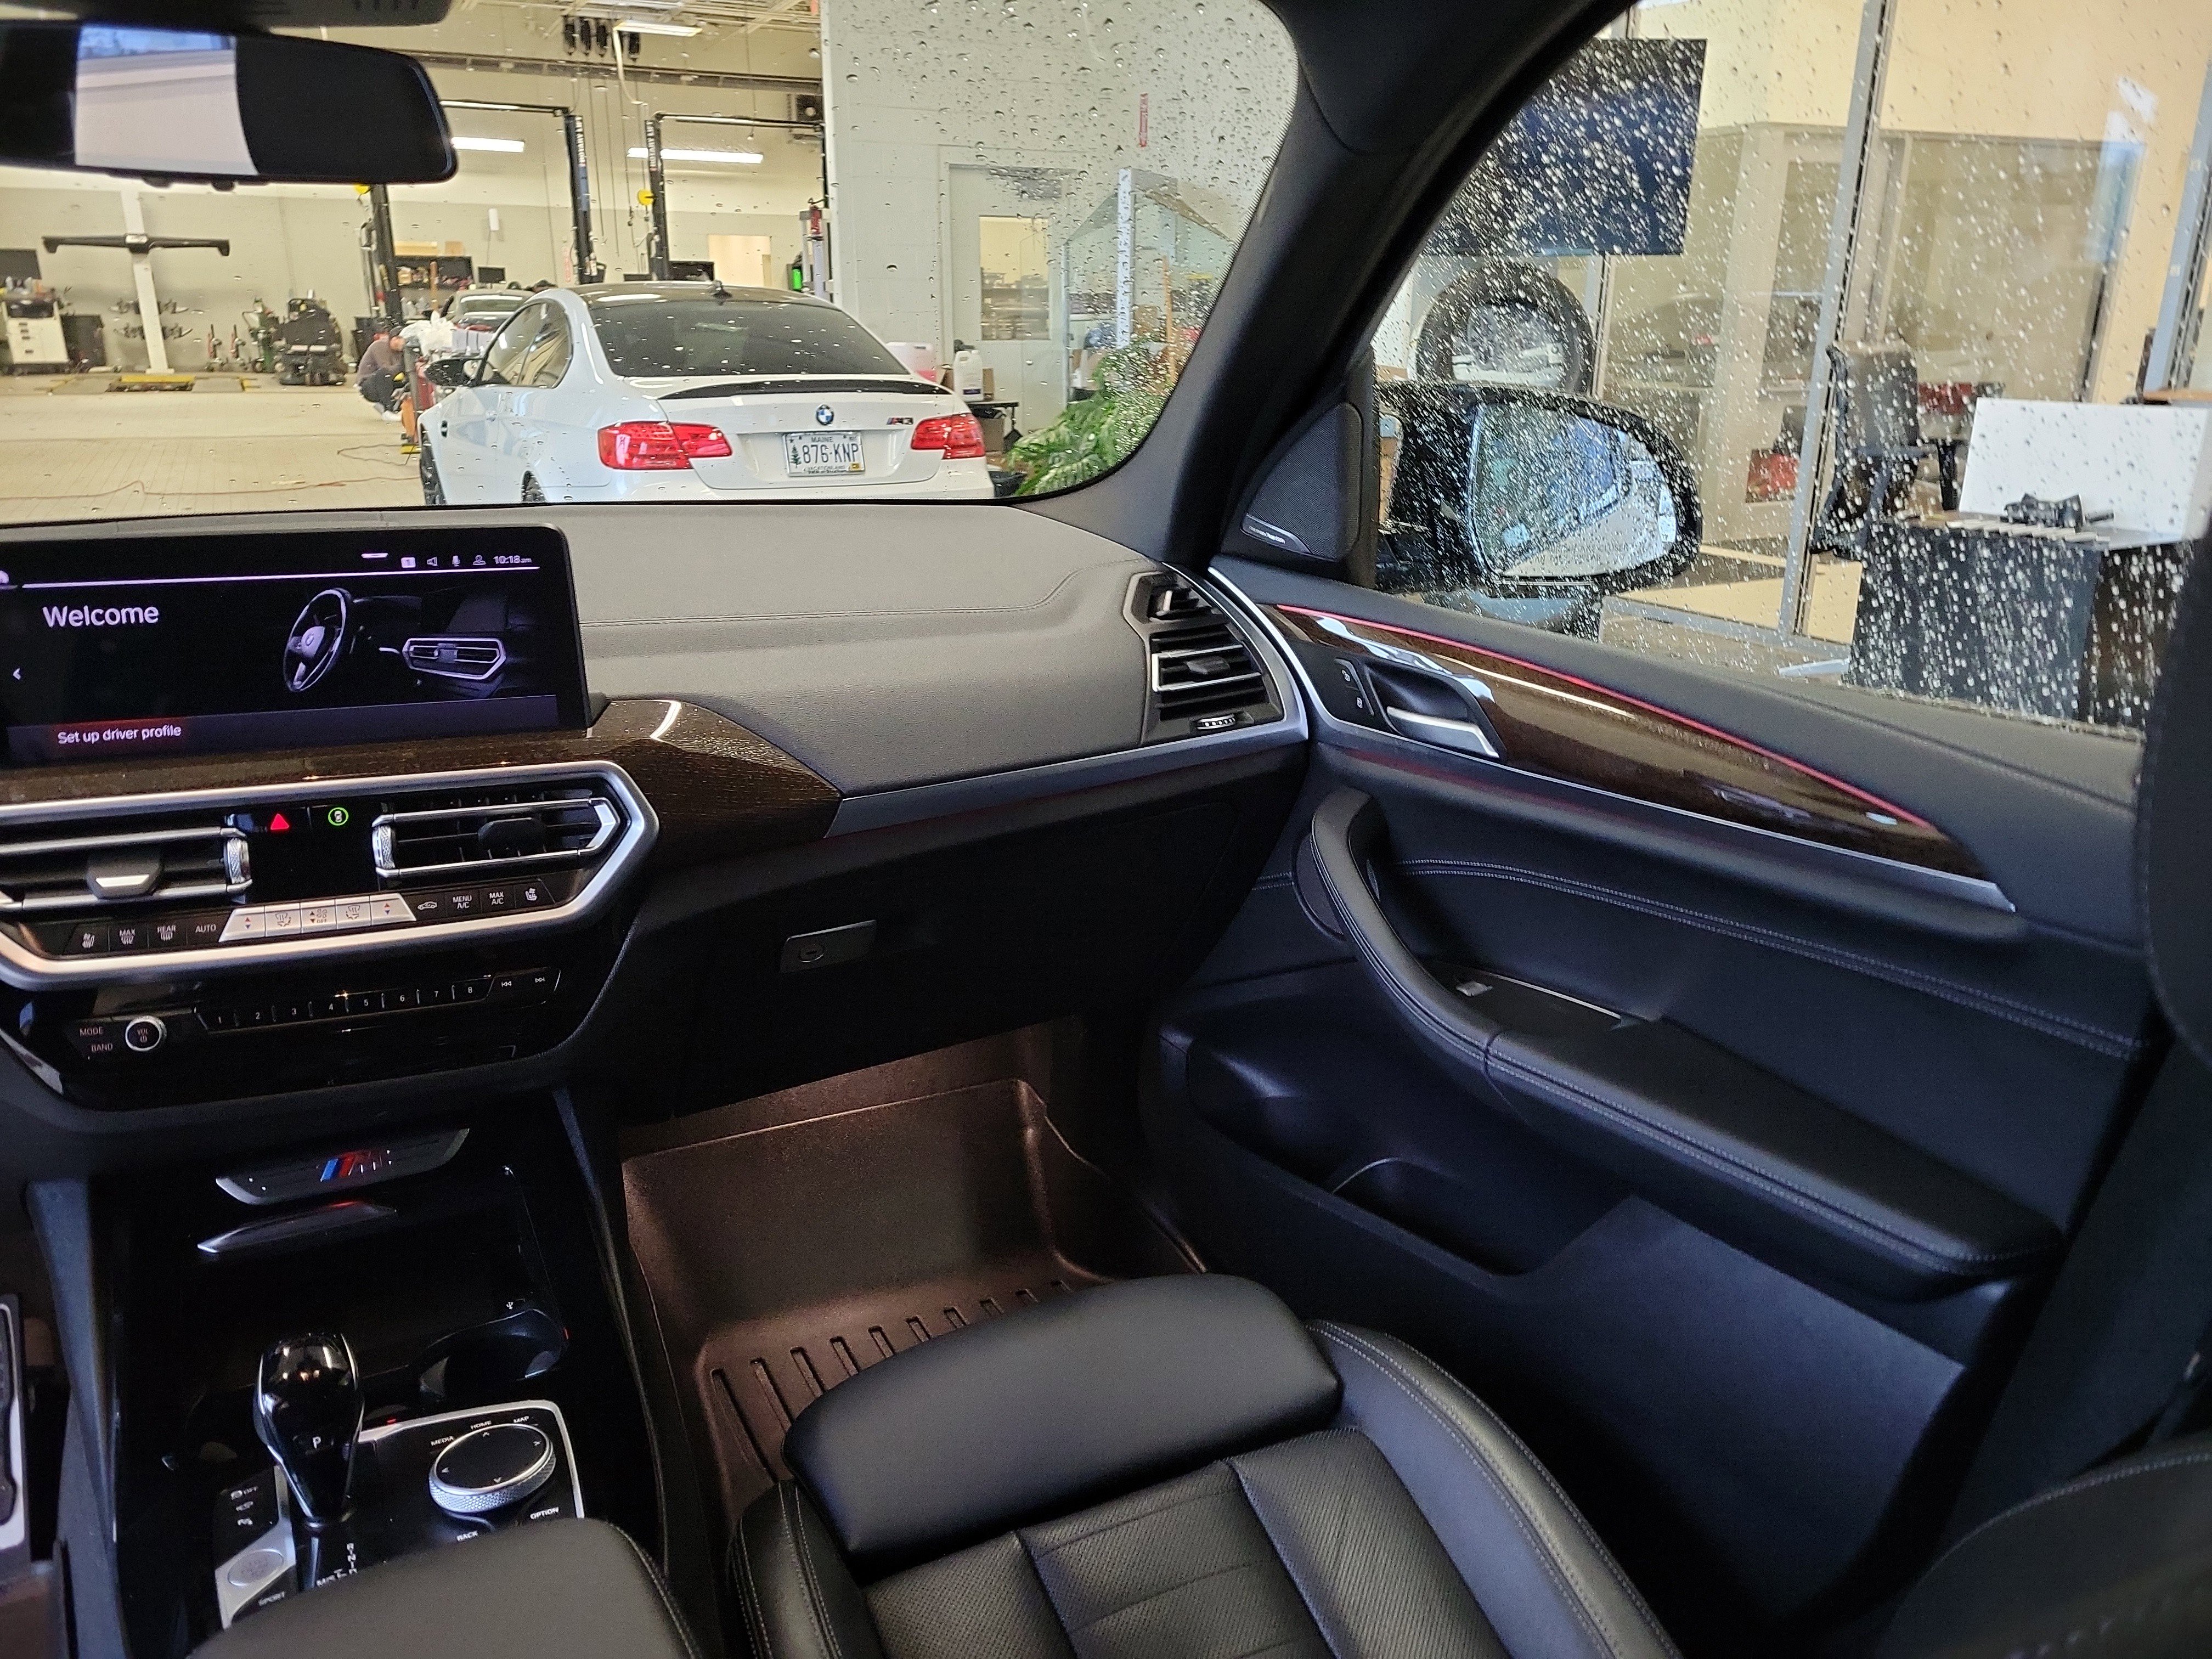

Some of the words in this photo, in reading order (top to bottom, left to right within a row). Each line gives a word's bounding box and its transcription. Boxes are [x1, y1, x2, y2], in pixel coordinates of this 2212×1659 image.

[802, 443, 859, 464] 876-KNP
[42, 605, 160, 628] Welcome
[58, 731, 80, 744] Set
[83, 731, 99, 744] up
[103, 729, 139, 741] driver
[142, 724, 182, 740] profile
[453, 895, 472, 903] MENU
[195, 924, 217, 933] AUTO
[256, 1012, 261, 1020] 2
[80, 1027, 103, 1036] MODE
[91, 1043, 113, 1052] BAND
[513, 1415, 529, 1424] MAP
[470, 1420, 492, 1430] HOME
[312, 1436, 321, 1449] P
[431, 1435, 454, 1446] MEDIA
[530, 1506, 560, 1520] OPTION
